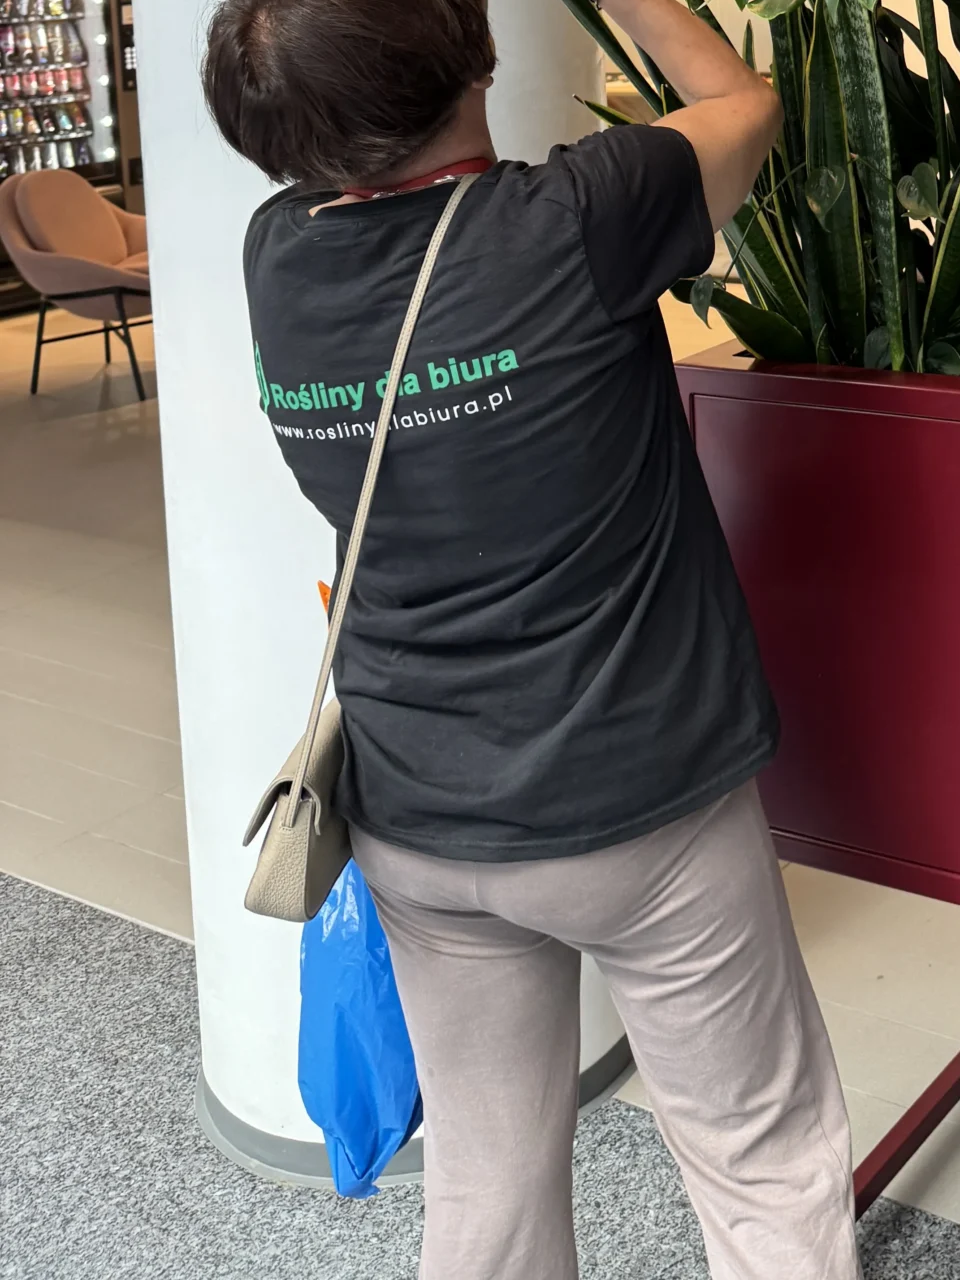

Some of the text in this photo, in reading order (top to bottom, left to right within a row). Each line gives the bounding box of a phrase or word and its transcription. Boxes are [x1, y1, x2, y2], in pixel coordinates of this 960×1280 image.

[269, 381, 365, 411] Rośliny
[427, 348, 519, 390] biura
[272, 385, 514, 440] www.roslinylabiura.pl
